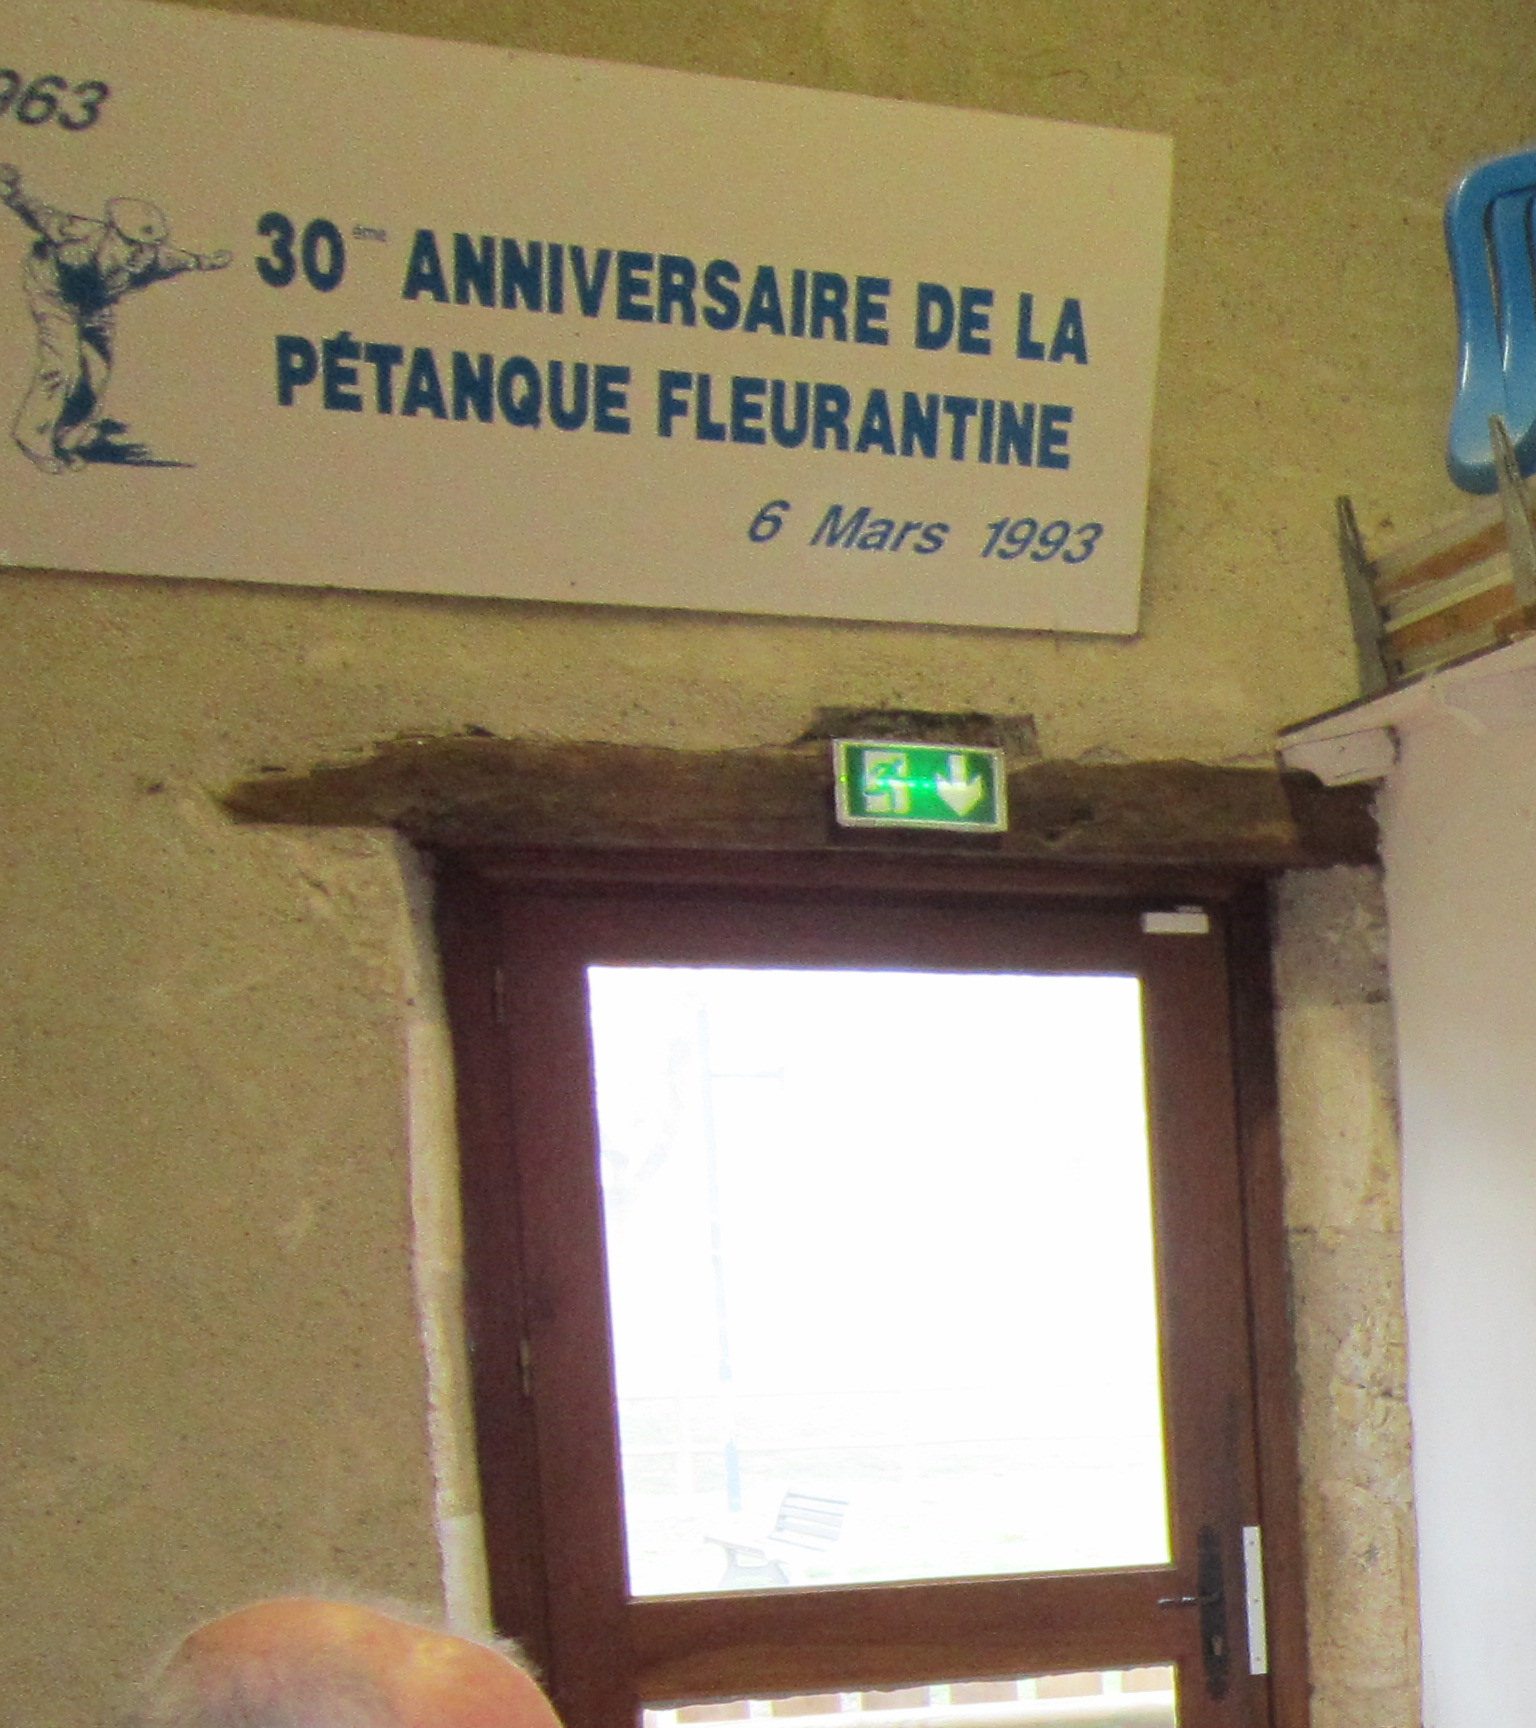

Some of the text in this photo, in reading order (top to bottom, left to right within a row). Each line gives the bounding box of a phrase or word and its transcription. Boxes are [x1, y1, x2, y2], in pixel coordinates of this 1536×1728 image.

[402, 228, 891, 346] ANNIVERSAIRE
[914, 282, 995, 355] DE
[1016, 292, 1089, 365] LA
[275, 330, 1074, 470] PÉTANQUE FLEURANTINE
[748, 499, 1105, 564] 6 Mars 1993
